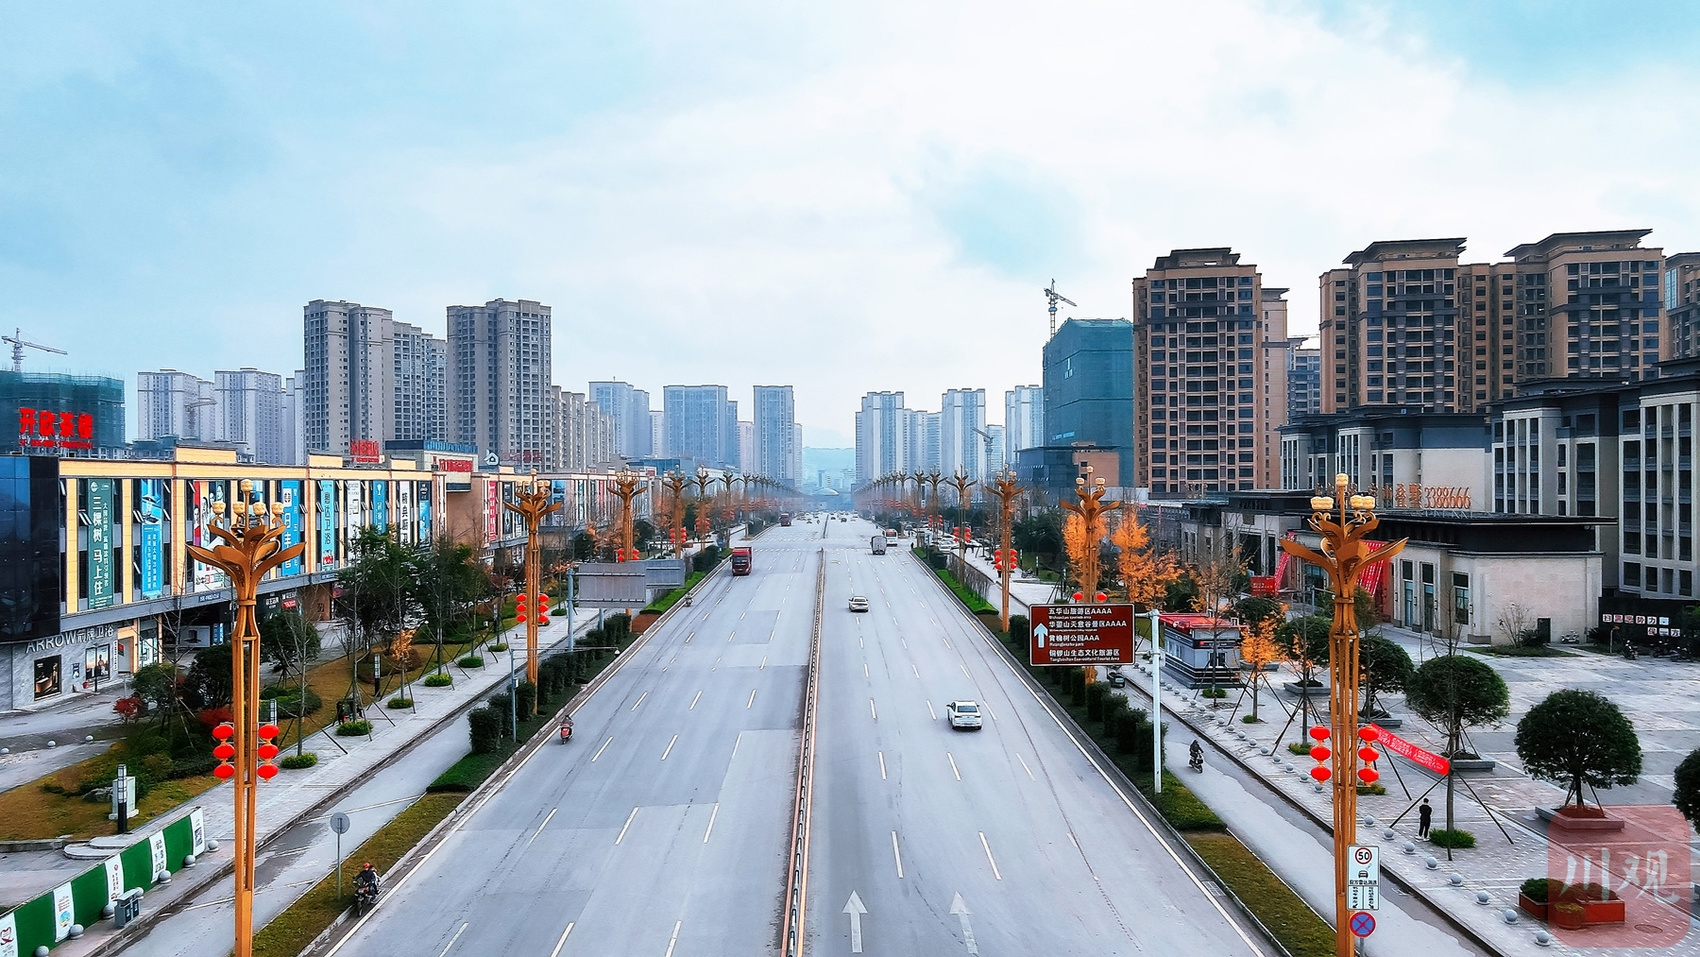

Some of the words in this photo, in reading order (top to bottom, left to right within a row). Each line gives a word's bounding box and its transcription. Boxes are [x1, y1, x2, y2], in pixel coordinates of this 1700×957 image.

[92, 496, 102, 543] 三棵树
[93, 549, 103, 596] 马上住
[26, 632, 77, 654] ARROW
[77, 624, 114, 643] 箭牌卫浴
[1358, 851, 1370, 861] 50
